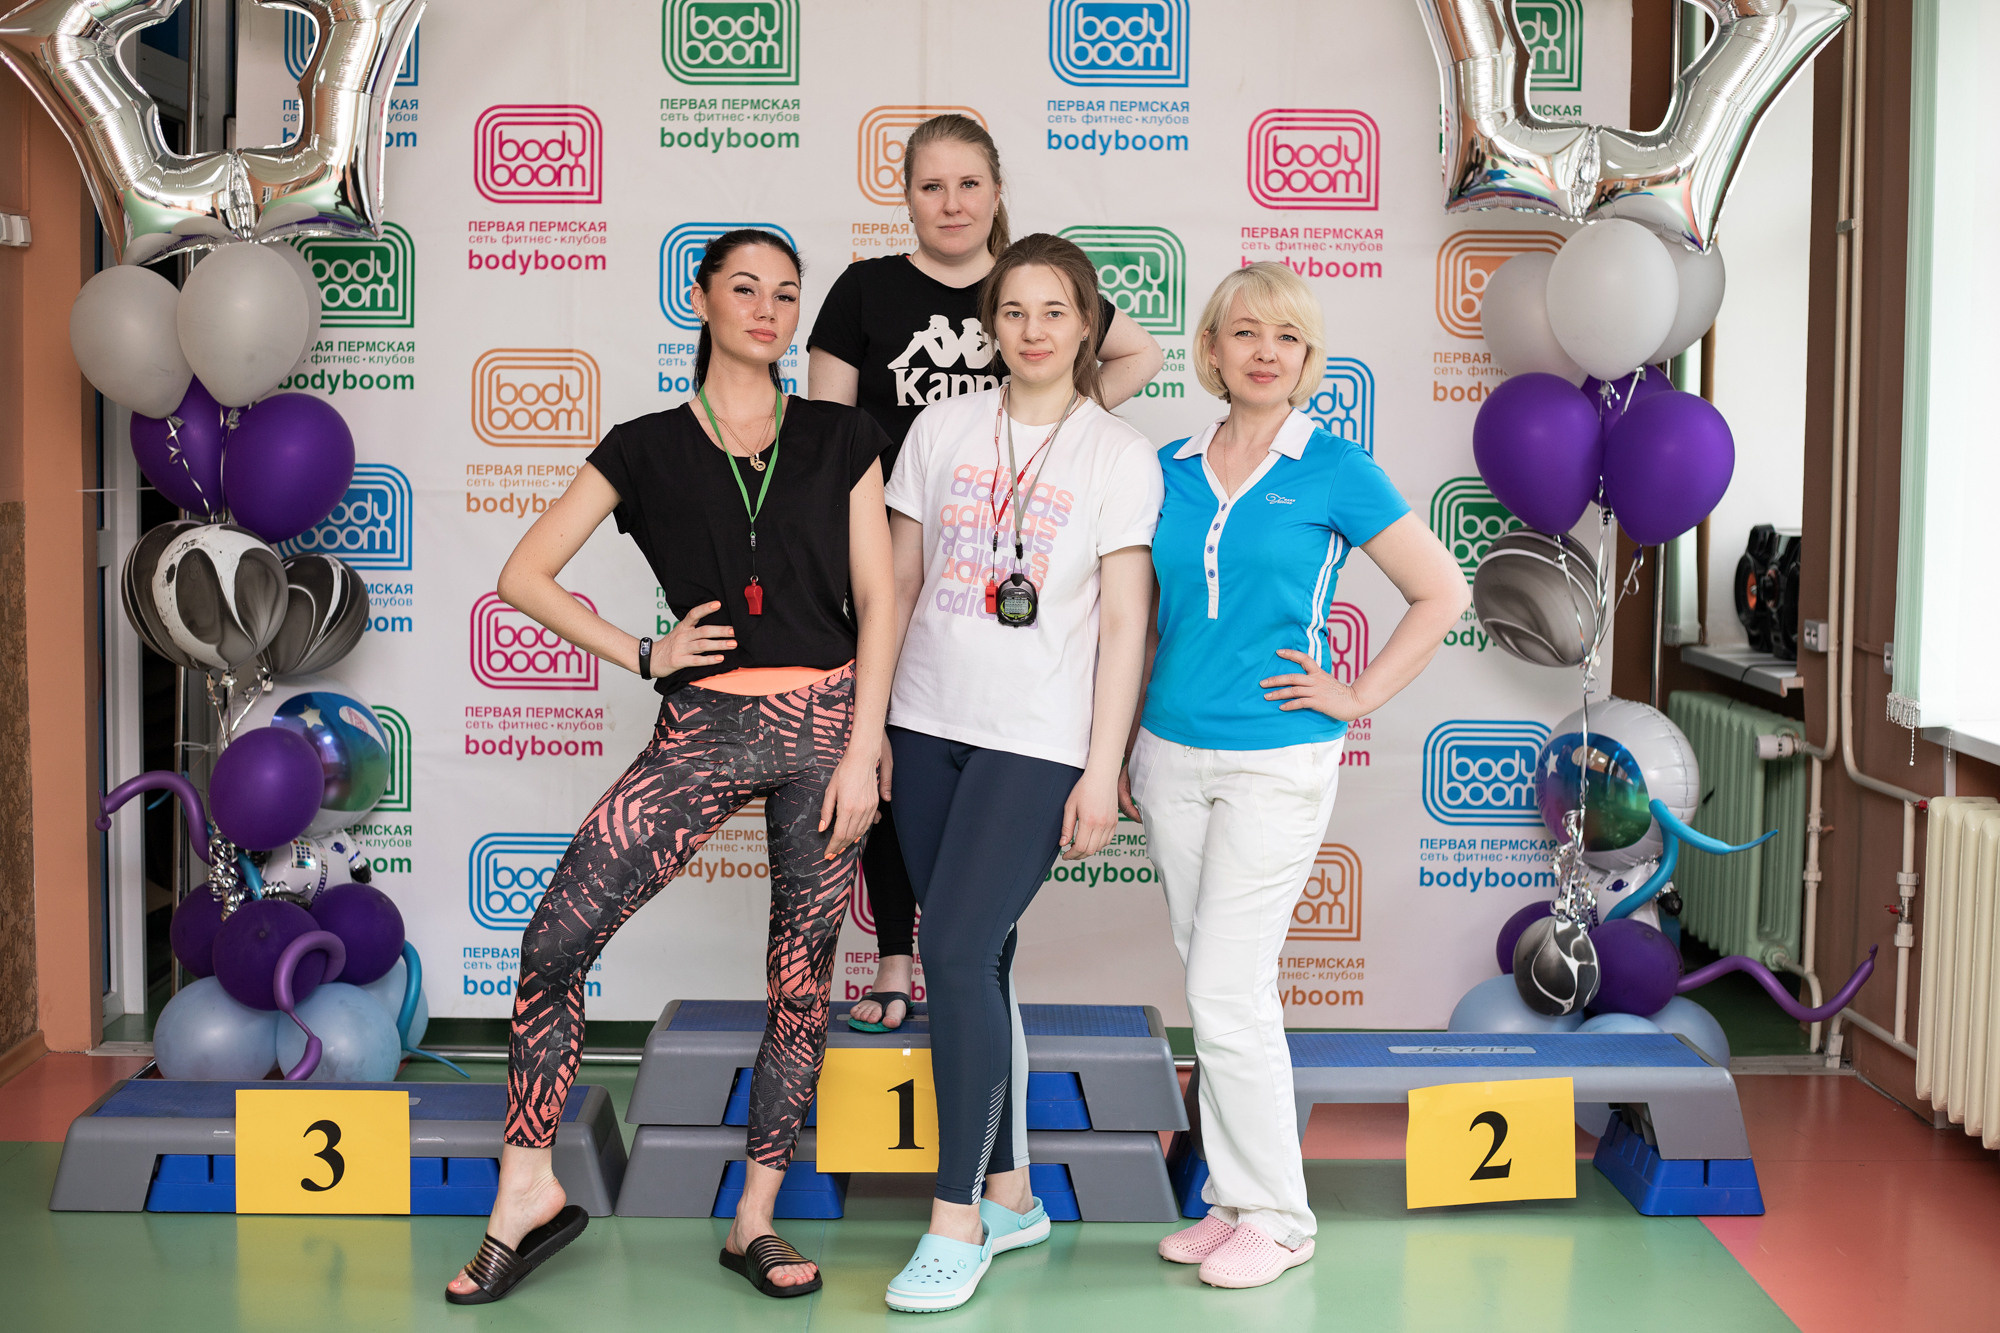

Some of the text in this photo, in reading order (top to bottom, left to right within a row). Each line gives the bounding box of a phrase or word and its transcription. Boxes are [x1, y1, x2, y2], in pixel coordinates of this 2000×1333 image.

[690, 6, 780, 40] body
[1077, 7, 1170, 40] body
[681, 40, 780, 65] boom
[1069, 41, 1170, 66] boom
[660, 98, 800, 110] ПЕРВАЯ ПЕРМСКАЯ
[1047, 100, 1190, 112] ПЕРВАЯ ПЕРМСКАЯ
[660, 112, 689, 122] сеть
[1047, 114, 1077, 123] сеть
[498, 130, 586, 161] body
[660, 127, 799, 153] bodyboom
[1047, 129, 1189, 156] bodyboom
[1273, 135, 1362, 167] body
[490, 163, 586, 187] boom
[1264, 169, 1362, 193] boom
[468, 221, 607, 232] ПЕРВАЯ ПЕРМСКАЯ
[852, 223, 909, 234] ПЕРВАЯ
[468, 235, 497, 244] сеть
[1241, 227, 1383, 240] ПЕРВАЯ ПЕРМСКАЯ
[852, 237, 919, 248] сеть фитн
[1241, 242, 1271, 250] сеть
[468, 249, 606, 275] bodyboom
[1098, 256, 1165, 290] ody
[320, 283, 395, 307] oom
[338, 341, 415, 352] ПЕРМСКАЯ
[658, 344, 696, 355] ПЕРВ
[658, 358, 687, 366] сеть
[1433, 352, 1491, 364] ПЕРВАЯ
[1433, 367, 1462, 376] сеть
[496, 374, 584, 405] body
[488, 408, 584, 431] boom
[466, 464, 522, 475] ПЕРВАЯ
[466, 478, 494, 487] сеть
[327, 492, 393, 526] ody
[366, 584, 413, 594] МСКАЯ
[487, 650, 582, 673] boom
[465, 707, 603, 719] ПЕРВАЯ ПЕРМСКАЯ
[465, 721, 493, 730] сеть
[465, 735, 603, 761] bodyboom
[1420, 838, 1557, 850] ПЕРВАЯ ПЕРМСКАЯ
[1420, 852, 1448, 861] сеть
[1420, 867, 1556, 893] bodyboom
[463, 947, 519, 959] ПЕРВАЯ
[463, 961, 492, 970] сеть
[1287, 958, 1365, 969] ПЕРМСКАЯ
[845, 966, 874, 975] сеть
[887, 1079, 925, 1150] 1
[1469, 1110, 1512, 1181] 2
[300, 1119, 345, 1192] 3
